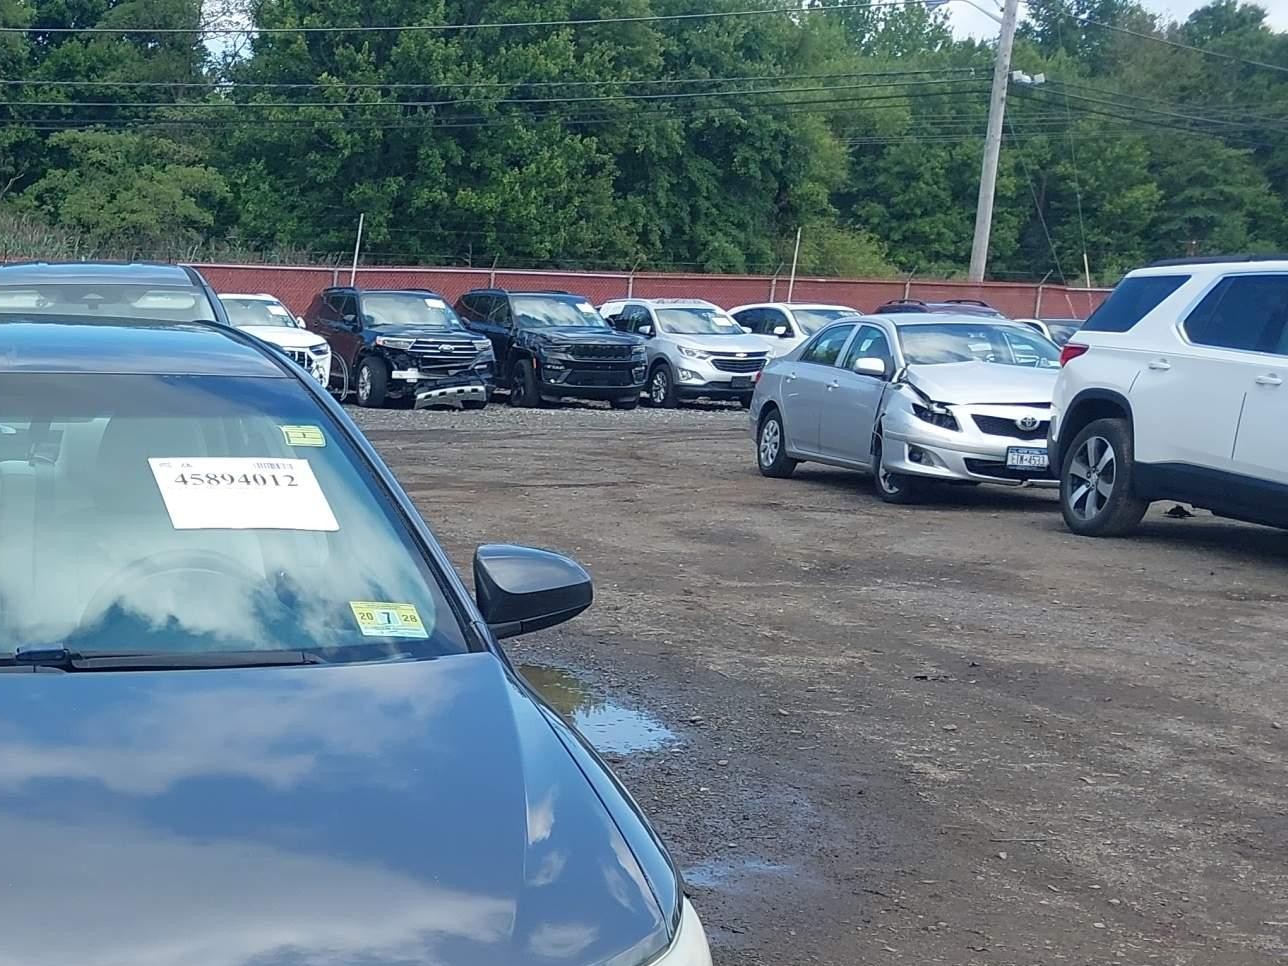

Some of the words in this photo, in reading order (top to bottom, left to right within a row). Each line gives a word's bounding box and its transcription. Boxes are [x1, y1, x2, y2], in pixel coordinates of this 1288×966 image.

[174, 472, 299, 487] 45894012
[358, 611, 374, 621] 20
[381, 611, 391, 624] 7
[401, 614, 418, 623] 28
